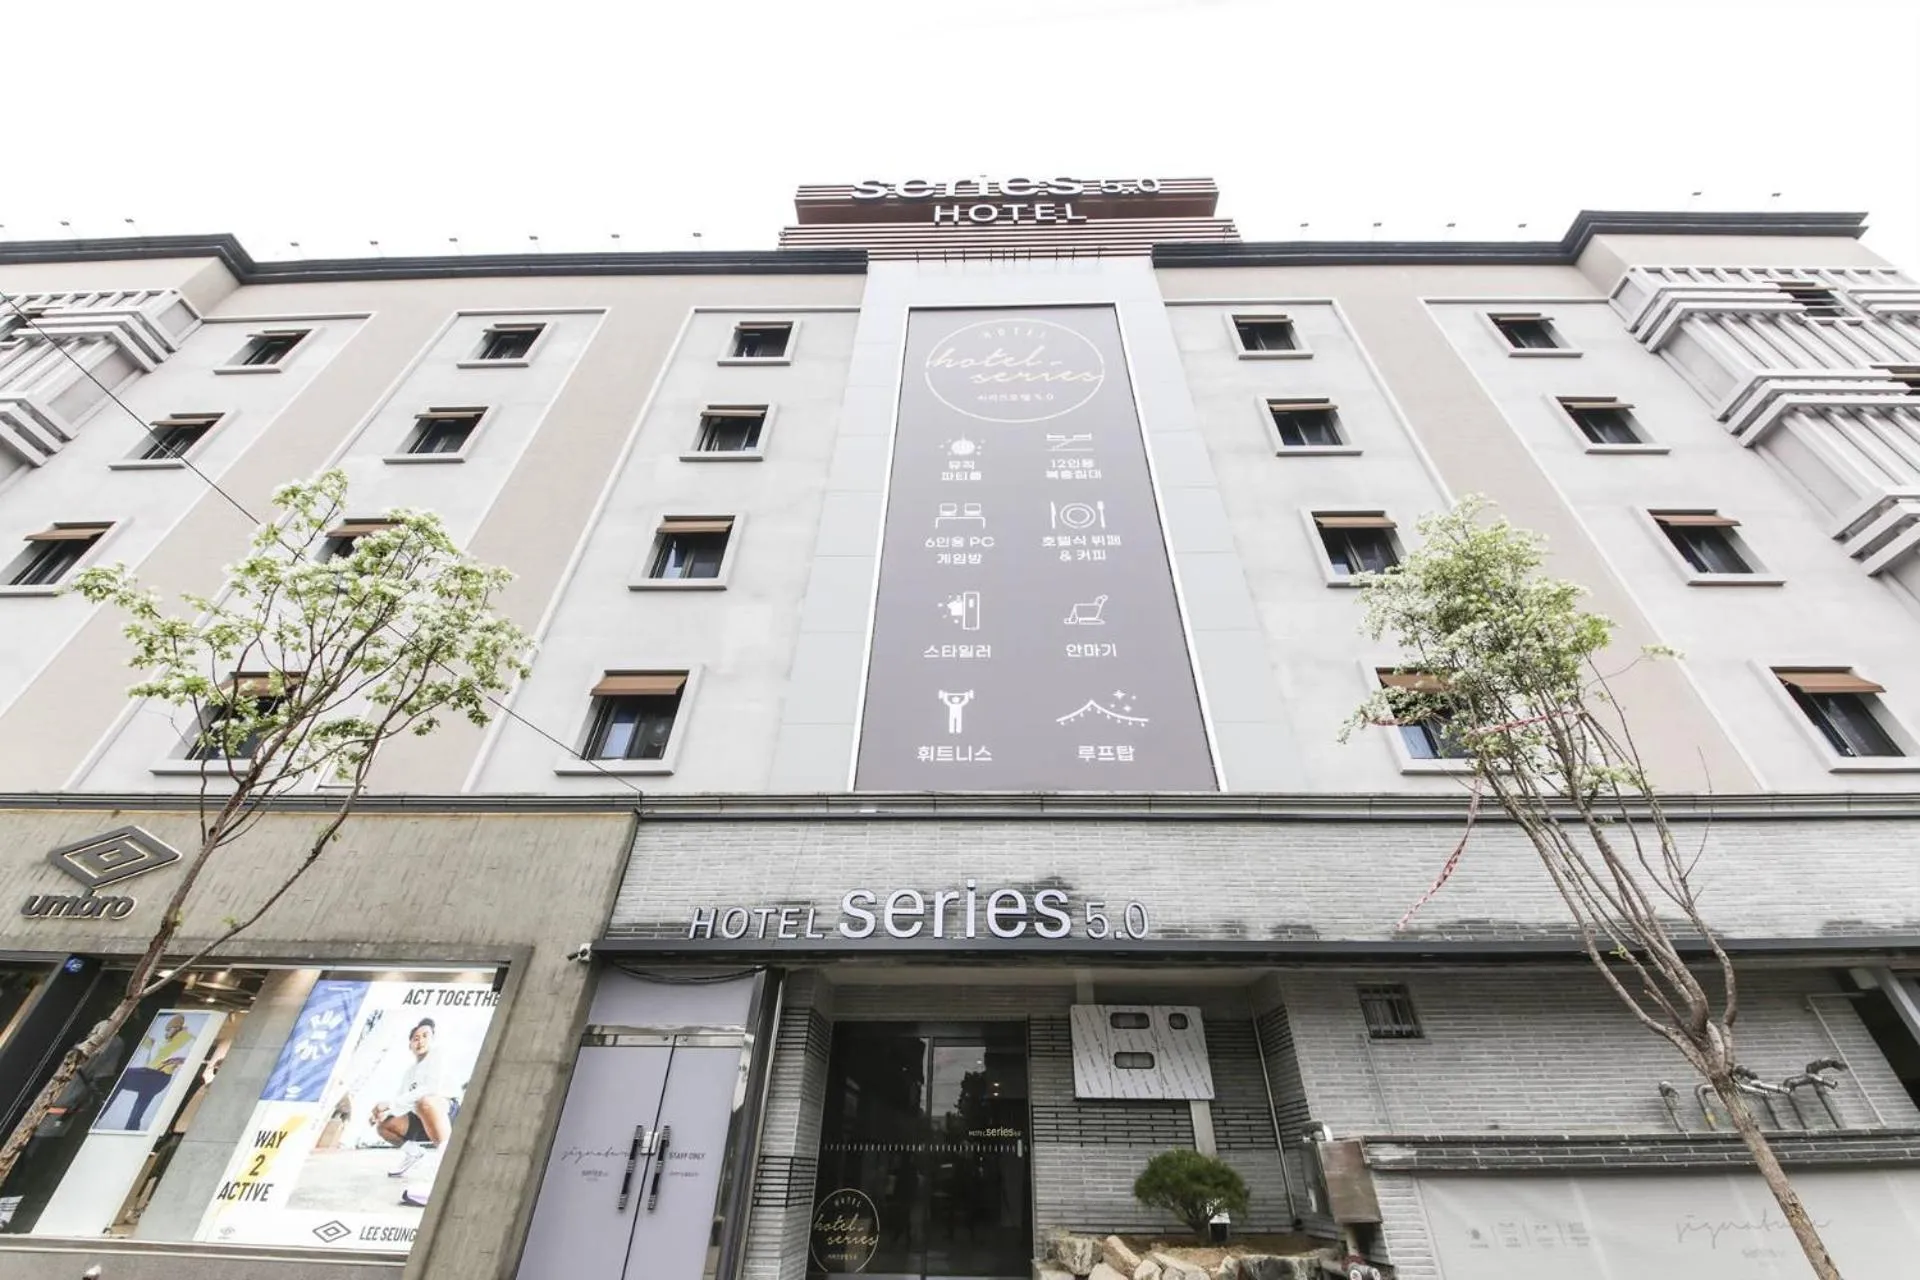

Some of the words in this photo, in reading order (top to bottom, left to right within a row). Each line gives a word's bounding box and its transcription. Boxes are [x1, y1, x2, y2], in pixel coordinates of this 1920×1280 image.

[852, 174, 1084, 199] series
[933, 203, 1087, 226] HOTEL
[925, 536, 965, 548] 6인용
[970, 536, 995, 547] PC
[937, 553, 983, 565] 게임방
[1059, 550, 1071, 561] &
[1077, 550, 1107, 561] 커피
[923, 644, 992, 659] 스타일러
[1066, 643, 1118, 658] 안마기
[917, 745, 993, 762] 휘트니스
[1077, 745, 1136, 762] 루프탑
[21, 889, 138, 919] umbro
[688, 907, 825, 940] HOTEL
[839, 879, 1072, 940] series
[1085, 902, 1151, 940] 5.0
[402, 988, 436, 1006] ACT
[254, 1130, 288, 1149] WAY
[986, 1126, 1015, 1137] series
[248, 1154, 266, 1177] 2
[217, 1182, 275, 1202] ACTIVE
[359, 1226, 383, 1241] LEE
